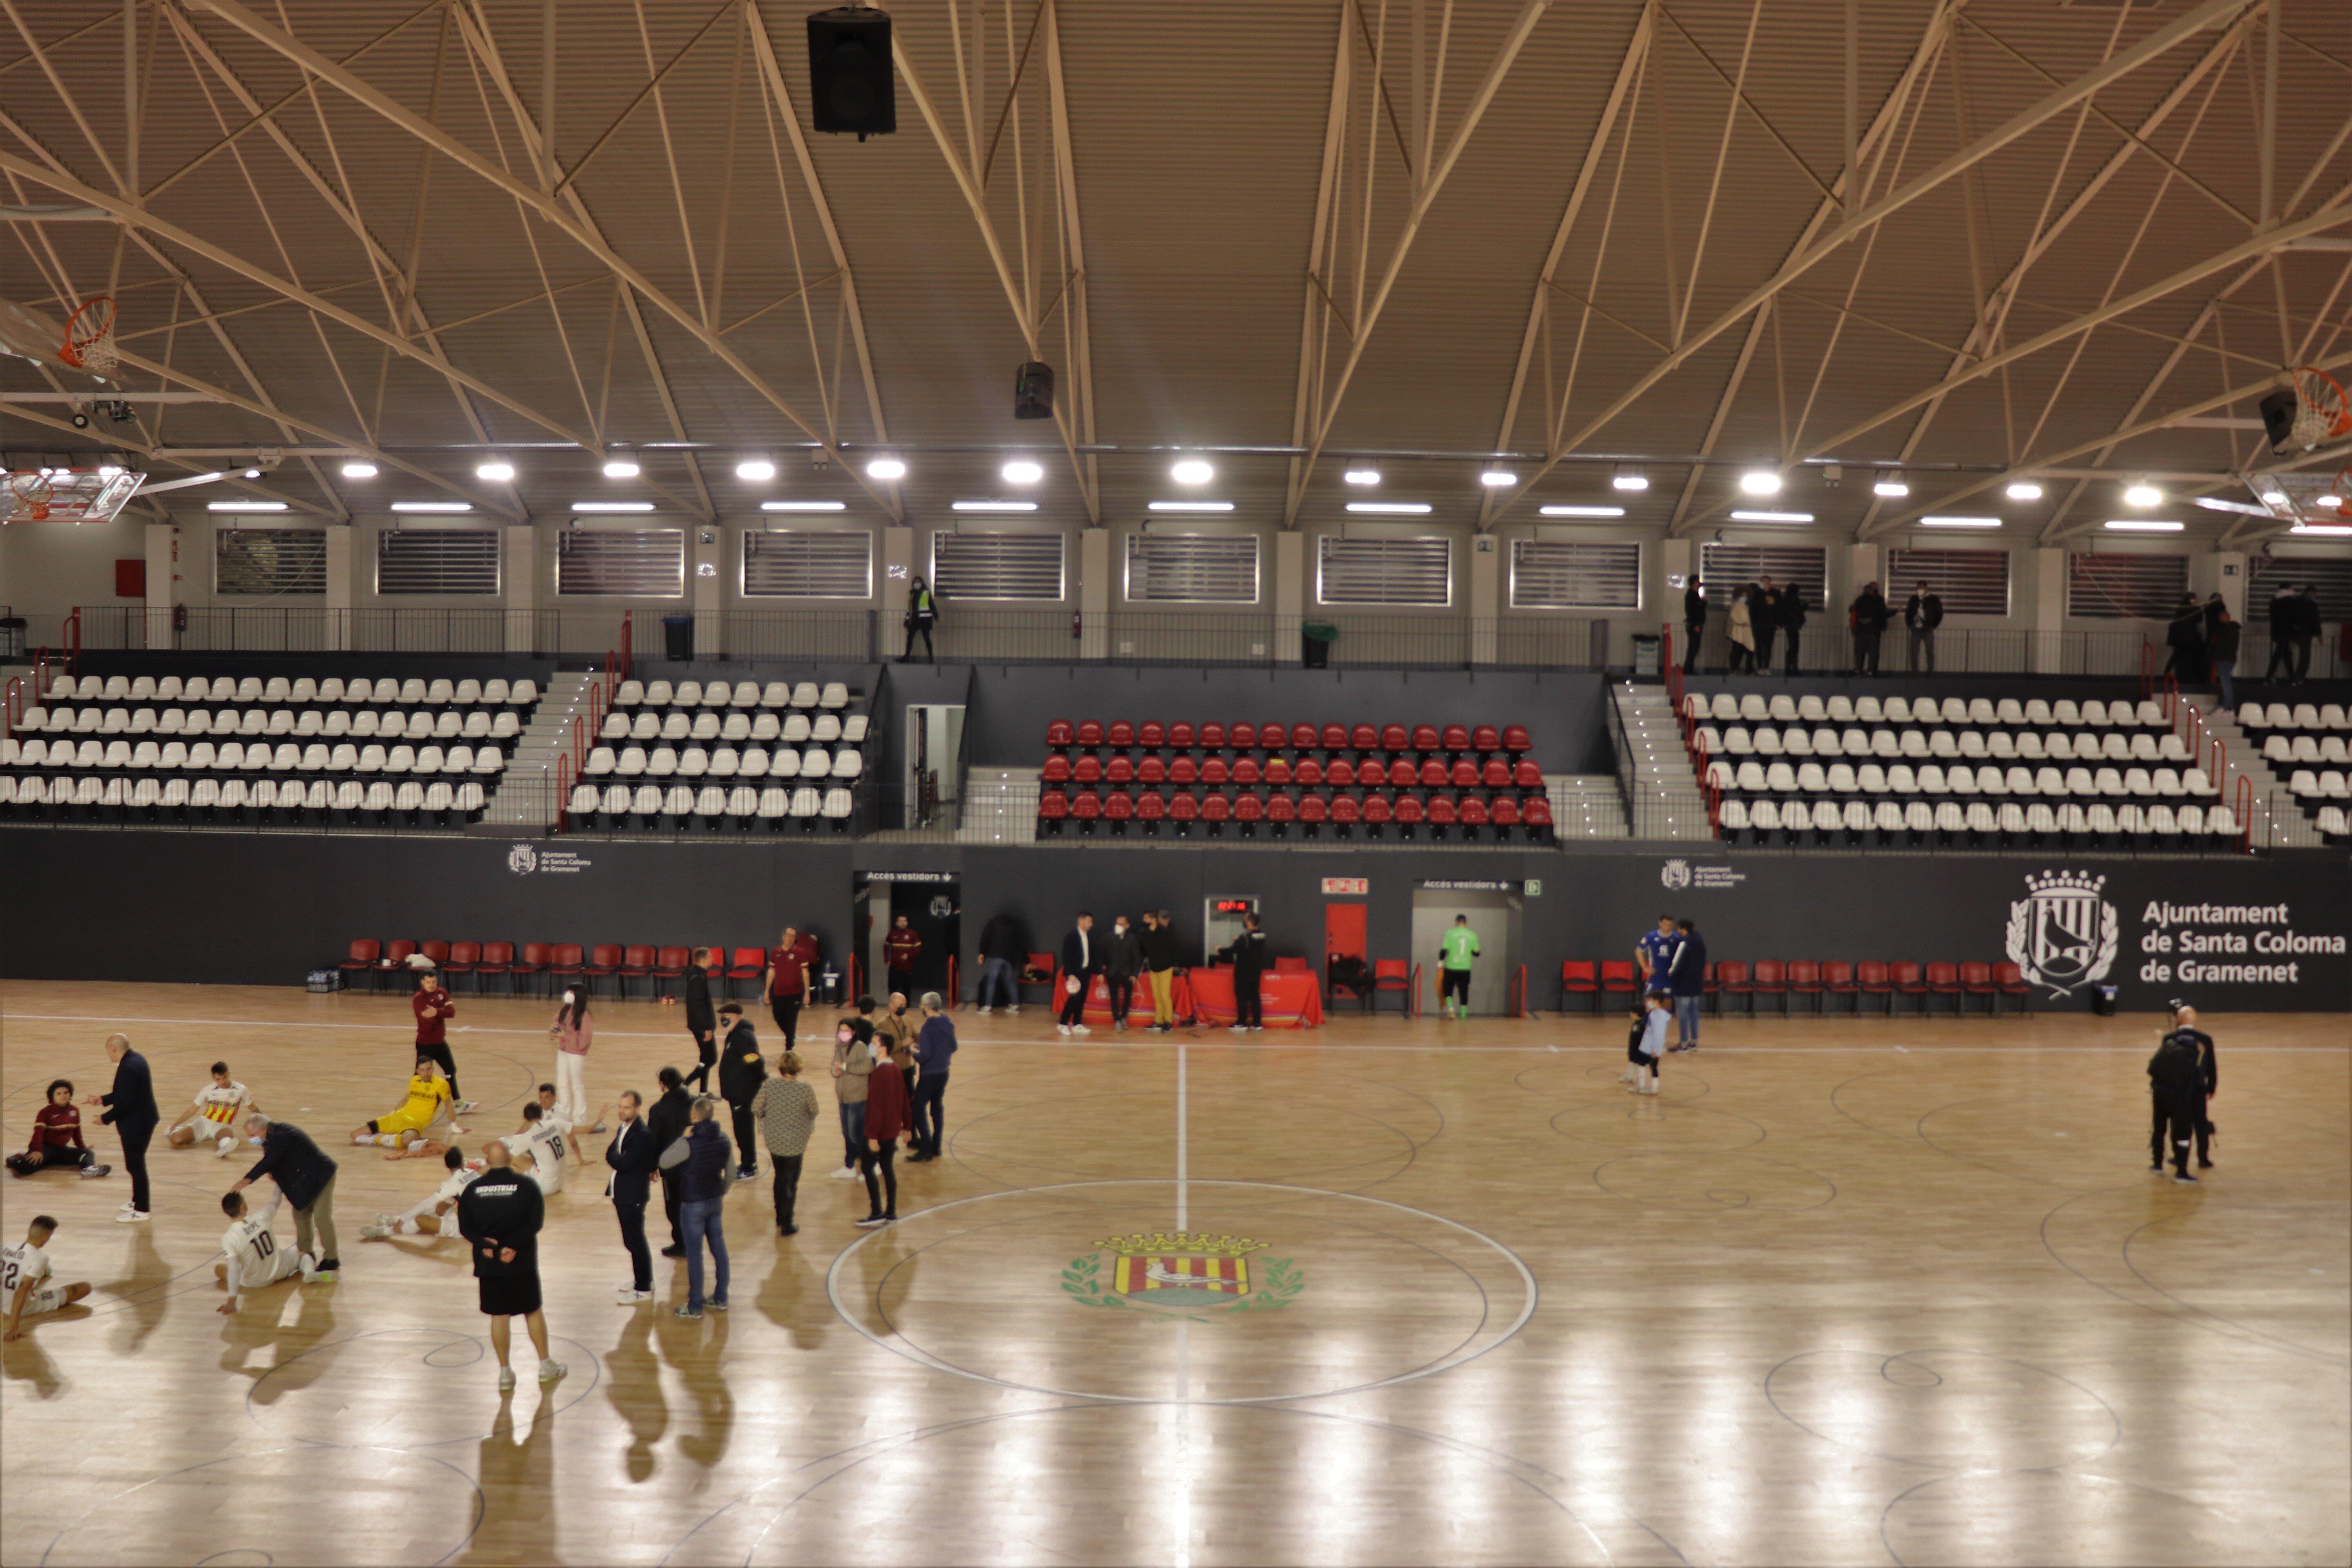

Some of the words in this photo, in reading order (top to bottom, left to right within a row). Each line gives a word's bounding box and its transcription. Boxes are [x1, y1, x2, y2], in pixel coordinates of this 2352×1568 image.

[2142, 901, 2288, 928] Ajuntament
[1459, 938, 1466, 955] 1
[2141, 930, 2172, 953] de
[2179, 931, 2247, 953] Santa
[2254, 930, 2346, 954] Coloma
[2140, 959, 2172, 982] de
[2177, 960, 2299, 984] Gramenet
[546, 1135, 565, 1161] 18
[475, 1184, 518, 1194] INDUSTRIAS
[250, 1229, 274, 1261] 10
